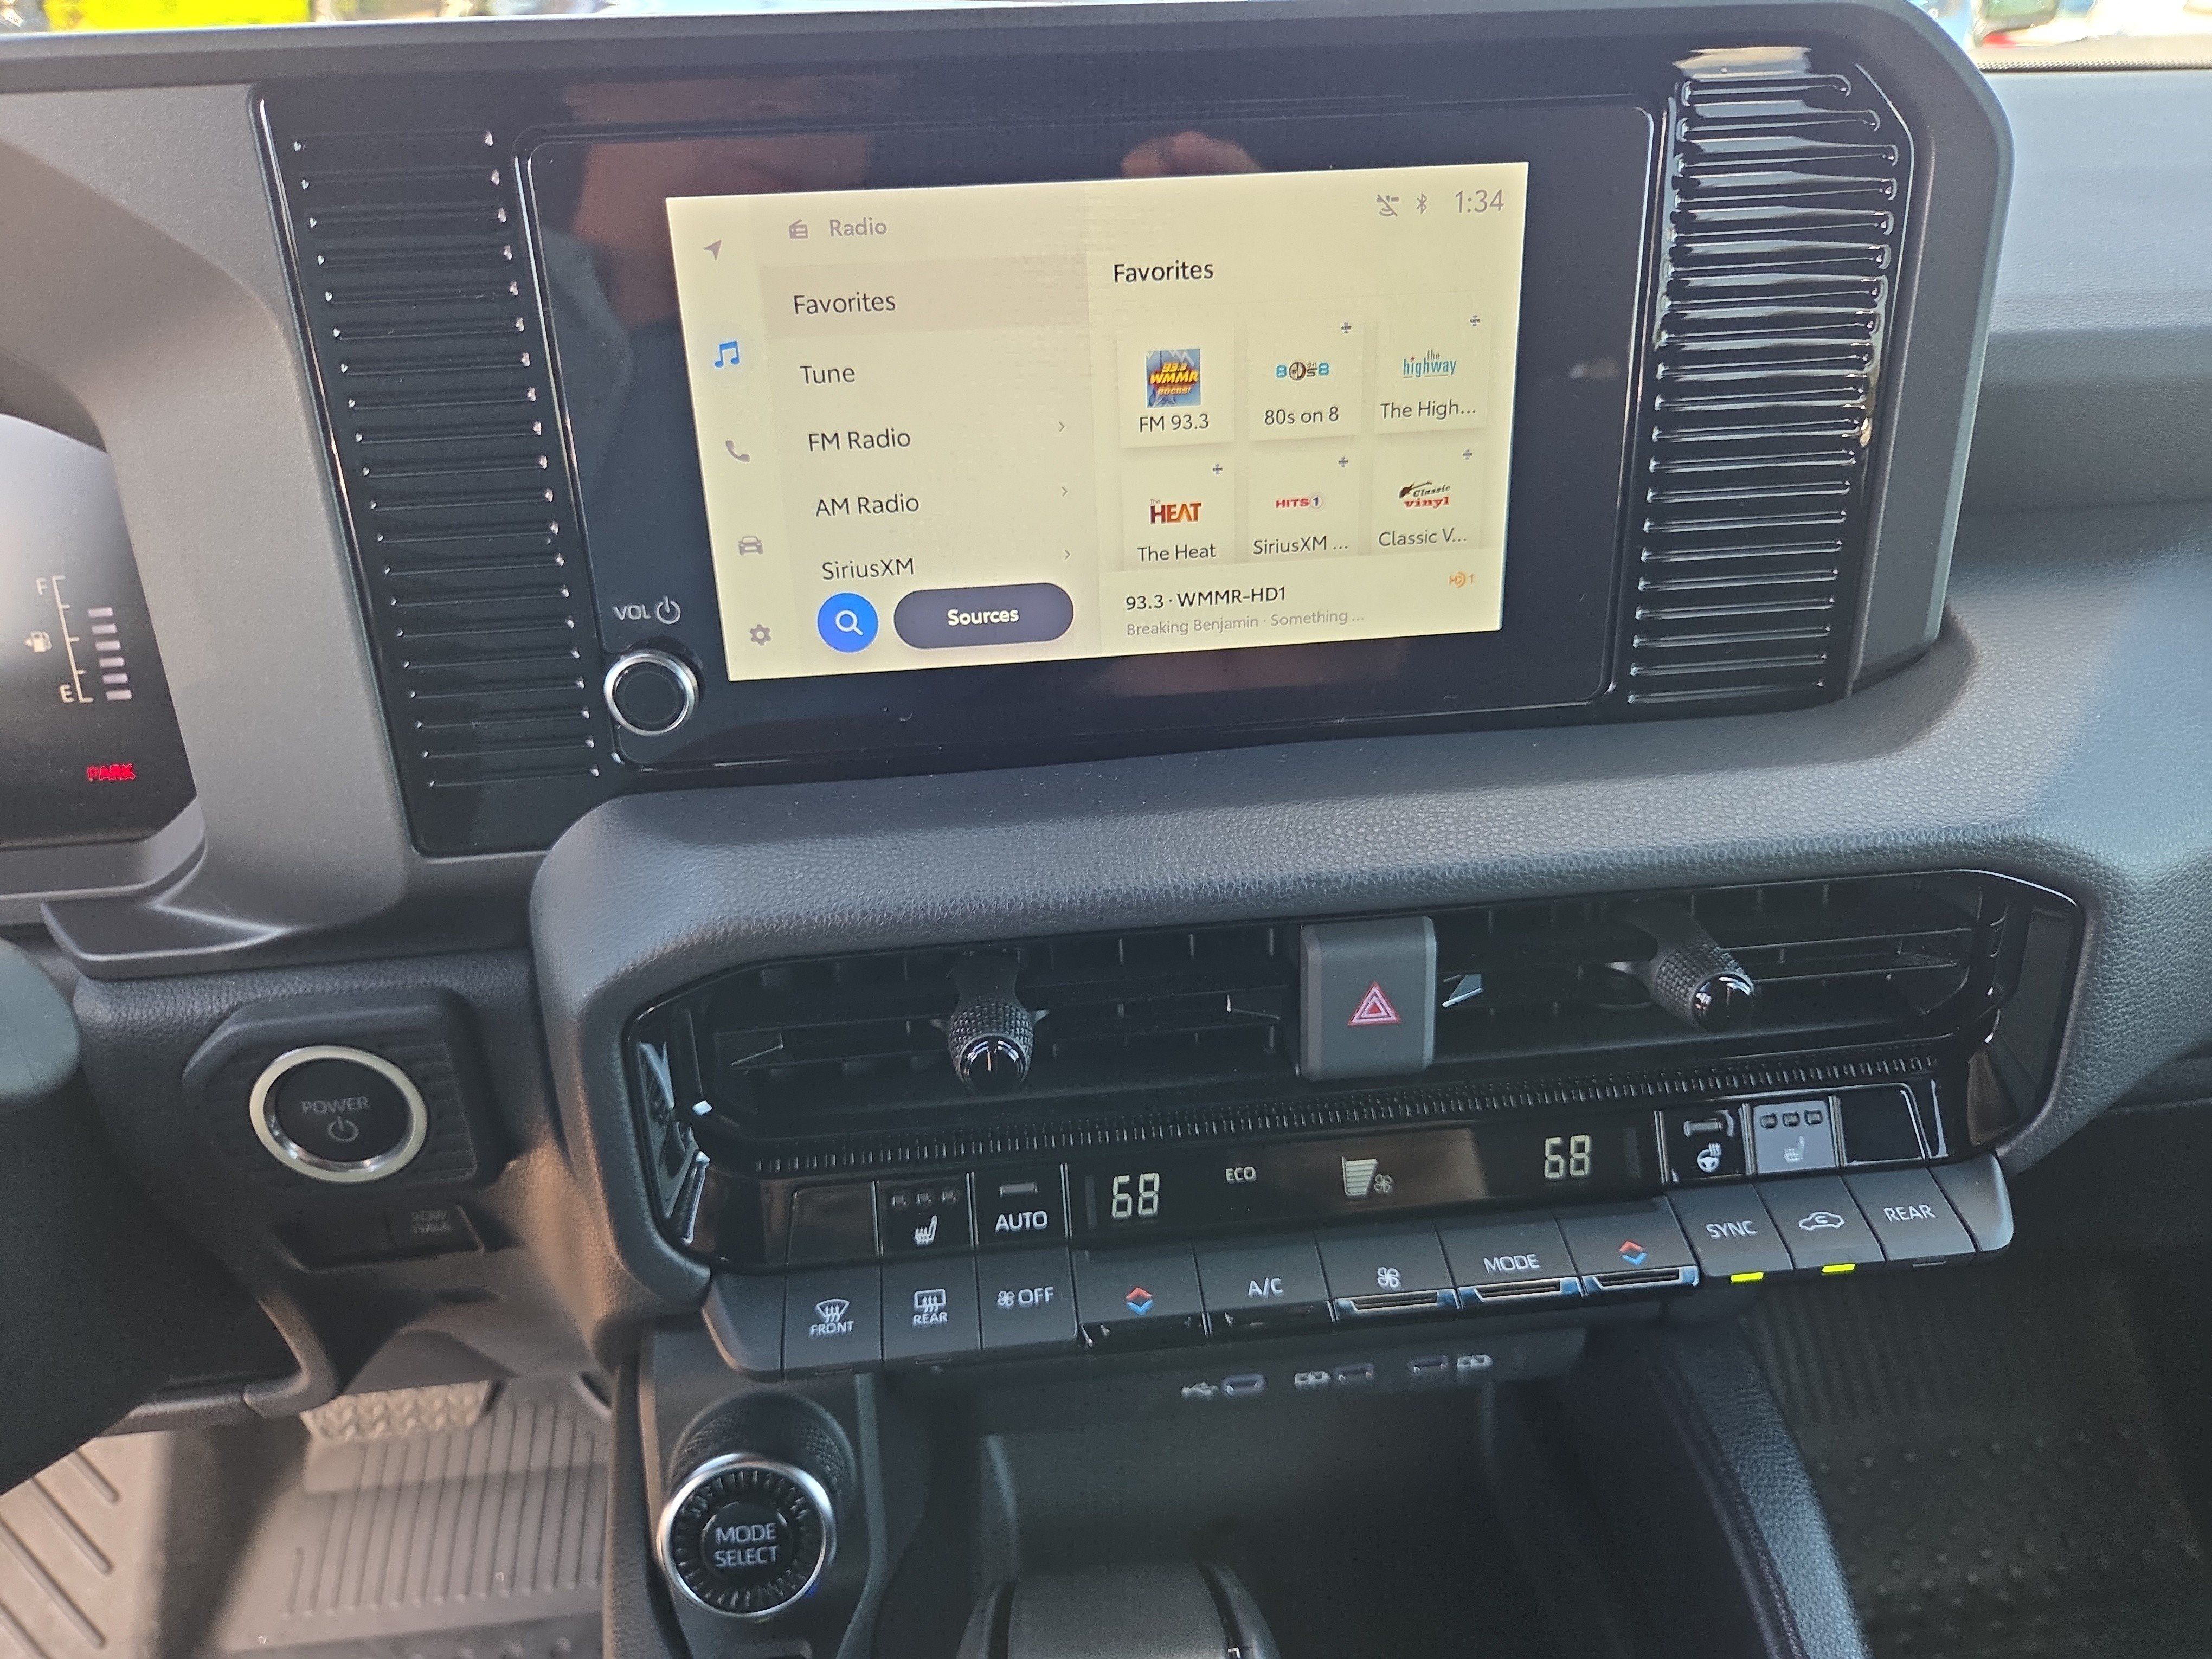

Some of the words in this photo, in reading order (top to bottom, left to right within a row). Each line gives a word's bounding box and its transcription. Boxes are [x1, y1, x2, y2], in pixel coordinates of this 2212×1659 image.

[1455, 189, 1504, 214] 1:34
[829, 218, 888, 237] Radio
[1113, 259, 1213, 284] Favorites
[793, 292, 896, 315] Favorites
[800, 365, 856, 384] Tune
[1403, 357, 1456, 377] highway
[1150, 370, 1198, 384] WMMR
[1264, 409, 1295, 425] 80s
[1301, 411, 1323, 424] on
[1329, 407, 1339, 422] 8
[1380, 403, 1412, 419] The
[1139, 416, 1165, 432] FM
[1171, 414, 1209, 430] 93.3
[808, 433, 839, 452] FM
[848, 429, 911, 449] Radio
[1413, 485, 1451, 497] Classic
[815, 498, 850, 517] AM
[857, 494, 919, 515] Radio
[1276, 499, 1309, 508] HITS
[1403, 496, 1449, 509] vinyl
[1150, 503, 1201, 524] HEAT
[1253, 536, 1327, 555] SiriusXM
[1379, 529, 1438, 548] Classic
[1137, 546, 1169, 562] The
[1174, 544, 1217, 561] Heat
[822, 559, 915, 580] SiriusXM
[37, 578, 47, 594] F
[1126, 595, 1164, 611] 93.3
[1177, 587, 1285, 607] WMMR-HD1
[613, 605, 651, 620] VOL
[948, 608, 1019, 626] Sources
[1127, 621, 1188, 636] Breaking
[1193, 618, 1258, 633] Benjamin
[1271, 612, 1348, 627] Something
[60, 685, 74, 703] E
[87, 763, 136, 782] PARK
[301, 1096, 370, 1114] POWER
[1544, 1135, 1592, 1180] 68
[1225, 1166, 1257, 1183] ECO
[1111, 1173, 1160, 1219] 68
[995, 1211, 1048, 1233] AUTO
[1883, 1204, 1935, 1223] REAR
[1706, 1220, 1758, 1240] SYNC
[1483, 1253, 1541, 1275] MODE
[1018, 1287, 1054, 1307] OFF
[1248, 1278, 1284, 1299] A/C
[809, 1321, 854, 1335] FRONT
[913, 1311, 948, 1326] REAR
[716, 1523, 776, 1544] MODE
[715, 1546, 777, 1567] SELECT
